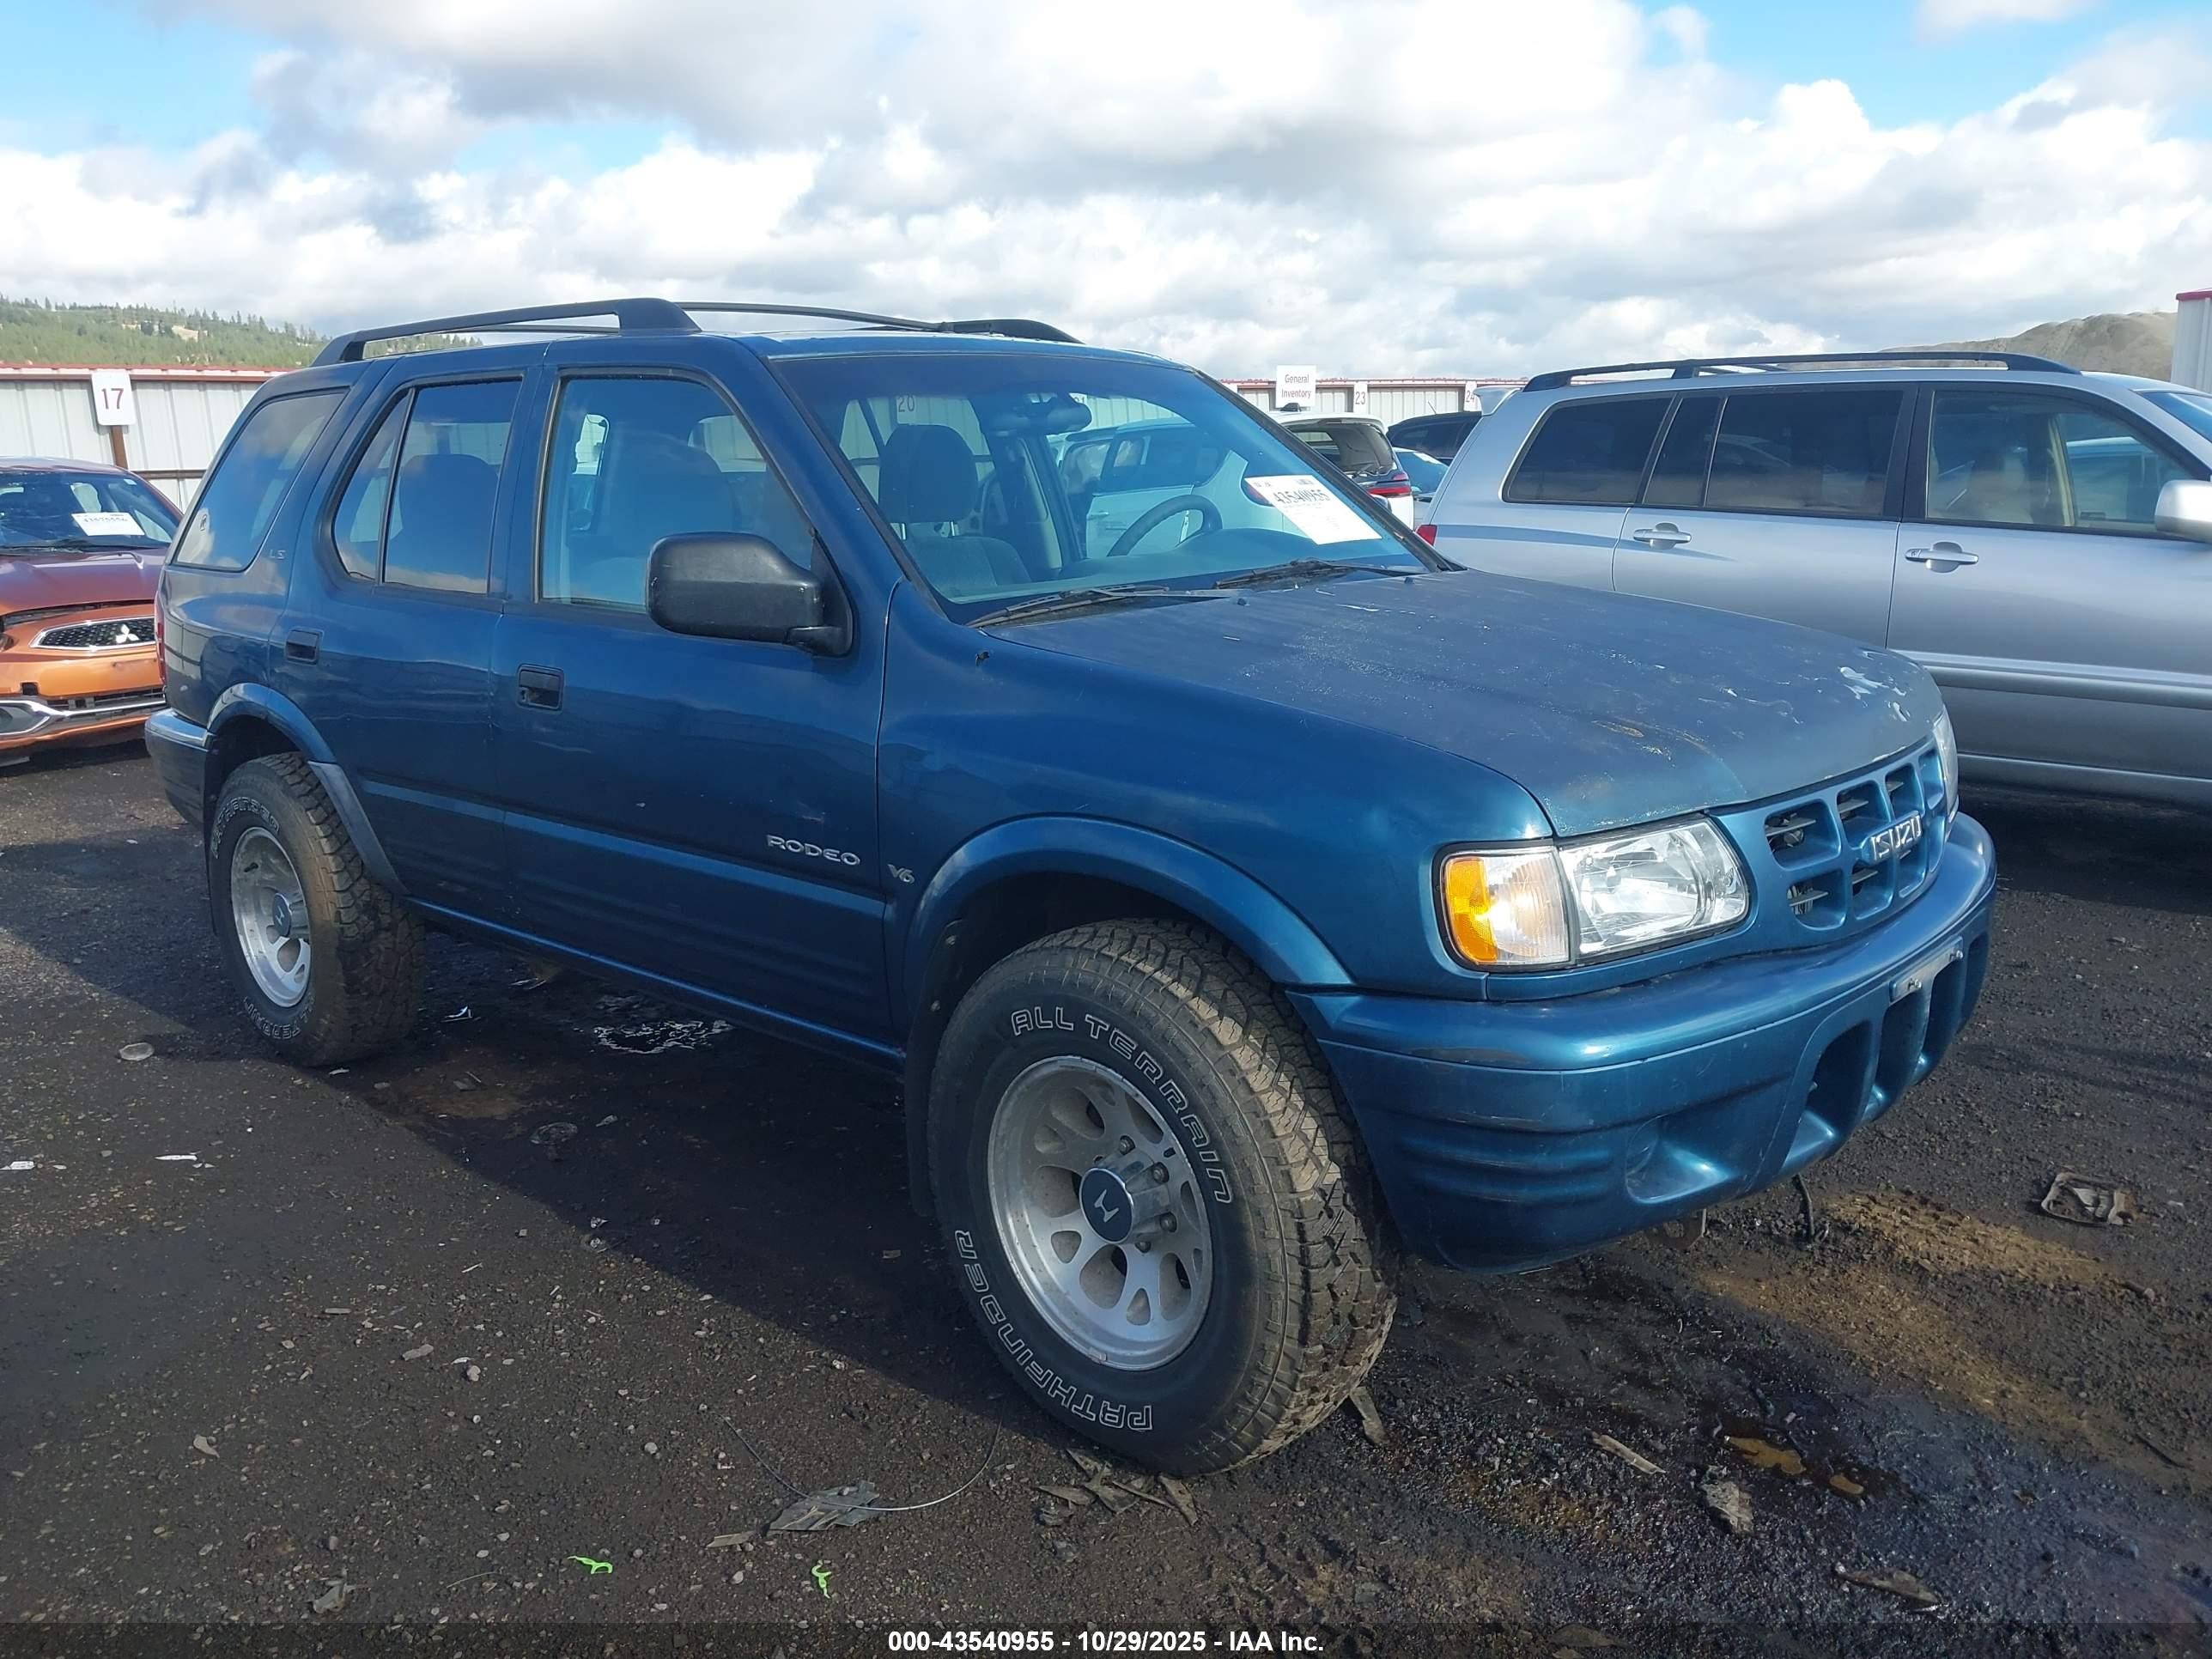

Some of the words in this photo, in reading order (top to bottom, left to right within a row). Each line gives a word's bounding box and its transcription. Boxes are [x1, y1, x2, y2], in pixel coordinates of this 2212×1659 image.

[1285, 374, 1310, 384] General
[100, 387, 125, 410] 17
[898, 395, 915, 413] 20
[1281, 389, 1312, 399] Inventory
[1354, 391, 1366, 404] 23
[1870, 815, 1922, 861] ISUZU
[766, 835, 860, 866] RODEO
[888, 864, 915, 884] V6
[1011, 1006, 1074, 1036] ALL
[1085, 1013, 1232, 1204] TERRAIN
[954, 1230, 1153, 1431] PATHFINDER
